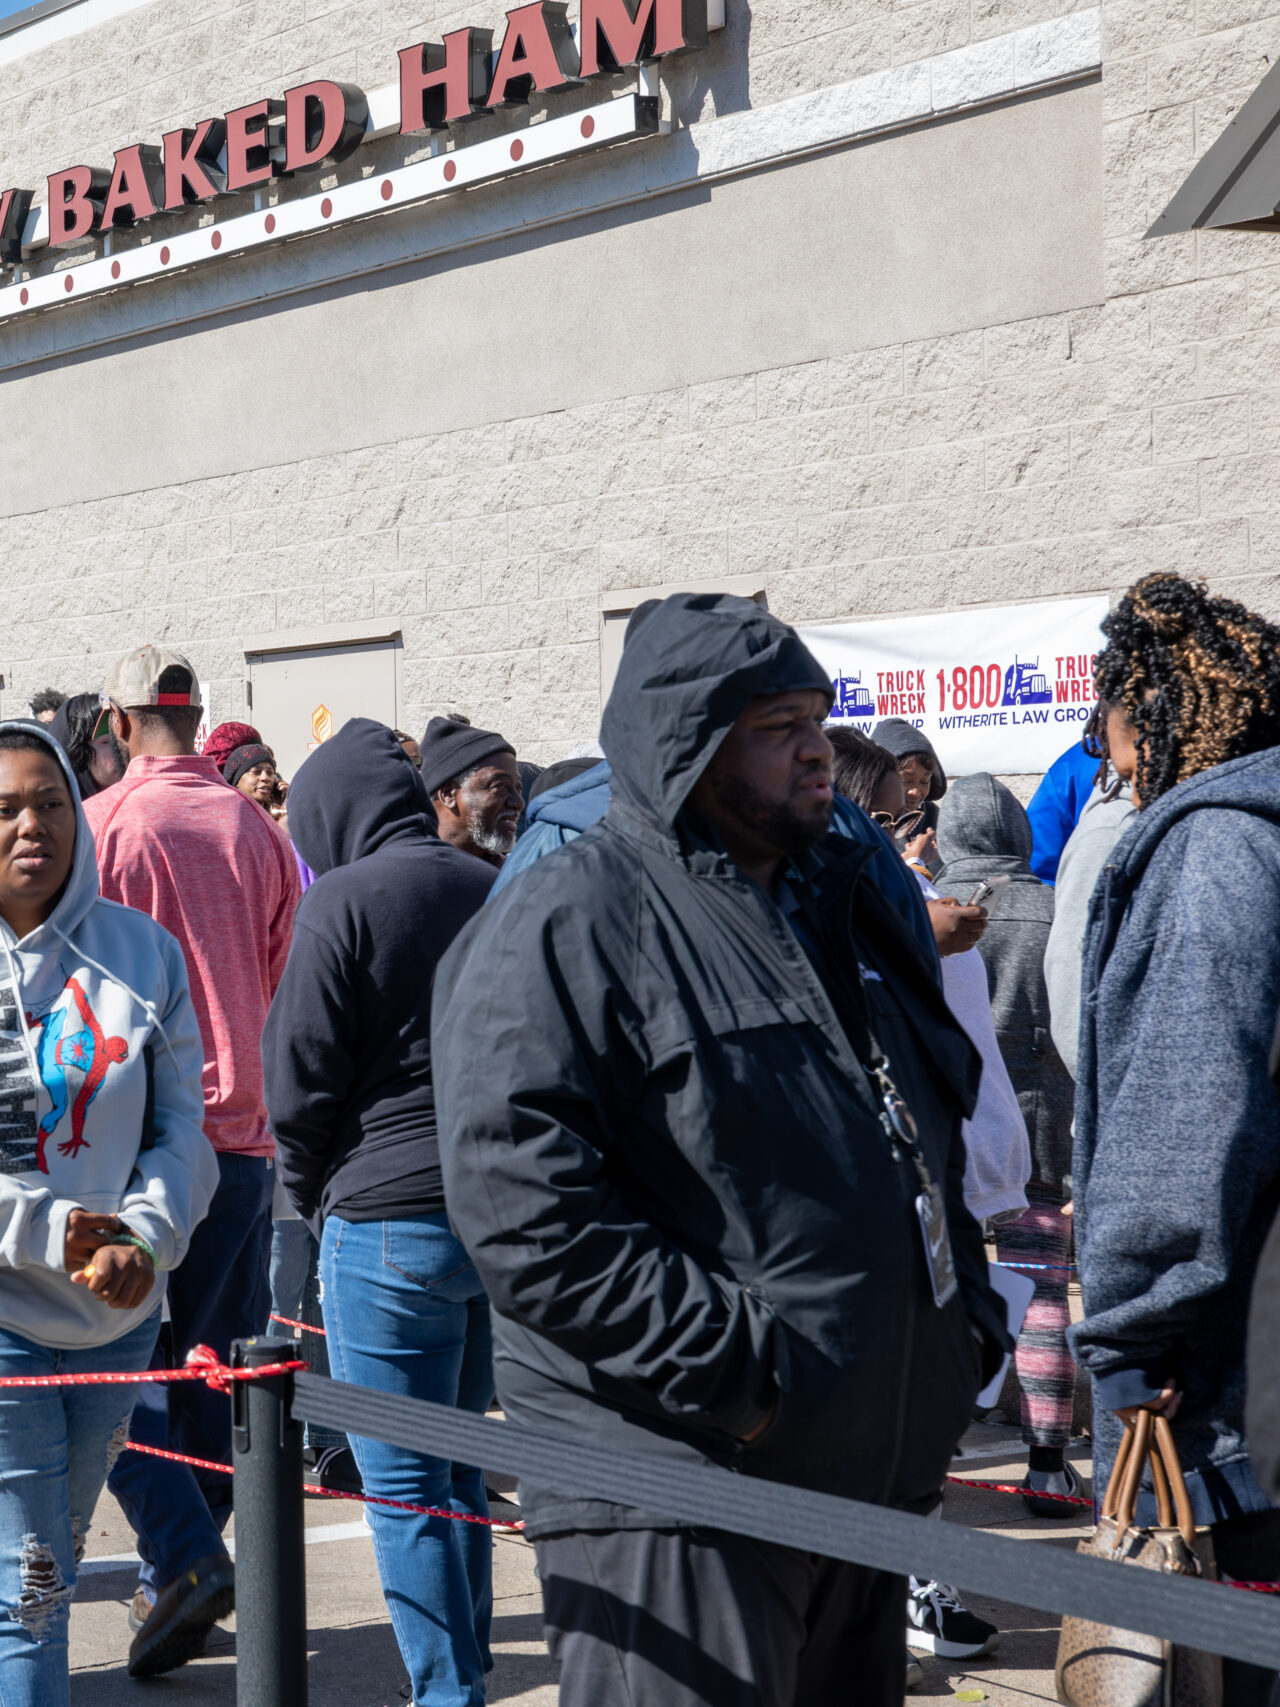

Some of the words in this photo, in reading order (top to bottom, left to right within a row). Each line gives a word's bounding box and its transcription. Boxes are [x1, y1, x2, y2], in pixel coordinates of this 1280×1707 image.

[49, 81, 345, 246] BAKED
[399, 0, 686, 135] HAM
[1055, 654, 1097, 679] TRUC
[876, 669, 925, 693] TRUCK
[1055, 679, 1100, 703] WREC
[876, 692, 926, 716] WRECK
[939, 712, 1008, 730] WITHERITE
[1012, 709, 1050, 725] LAW
[1054, 706, 1093, 723] GRO
